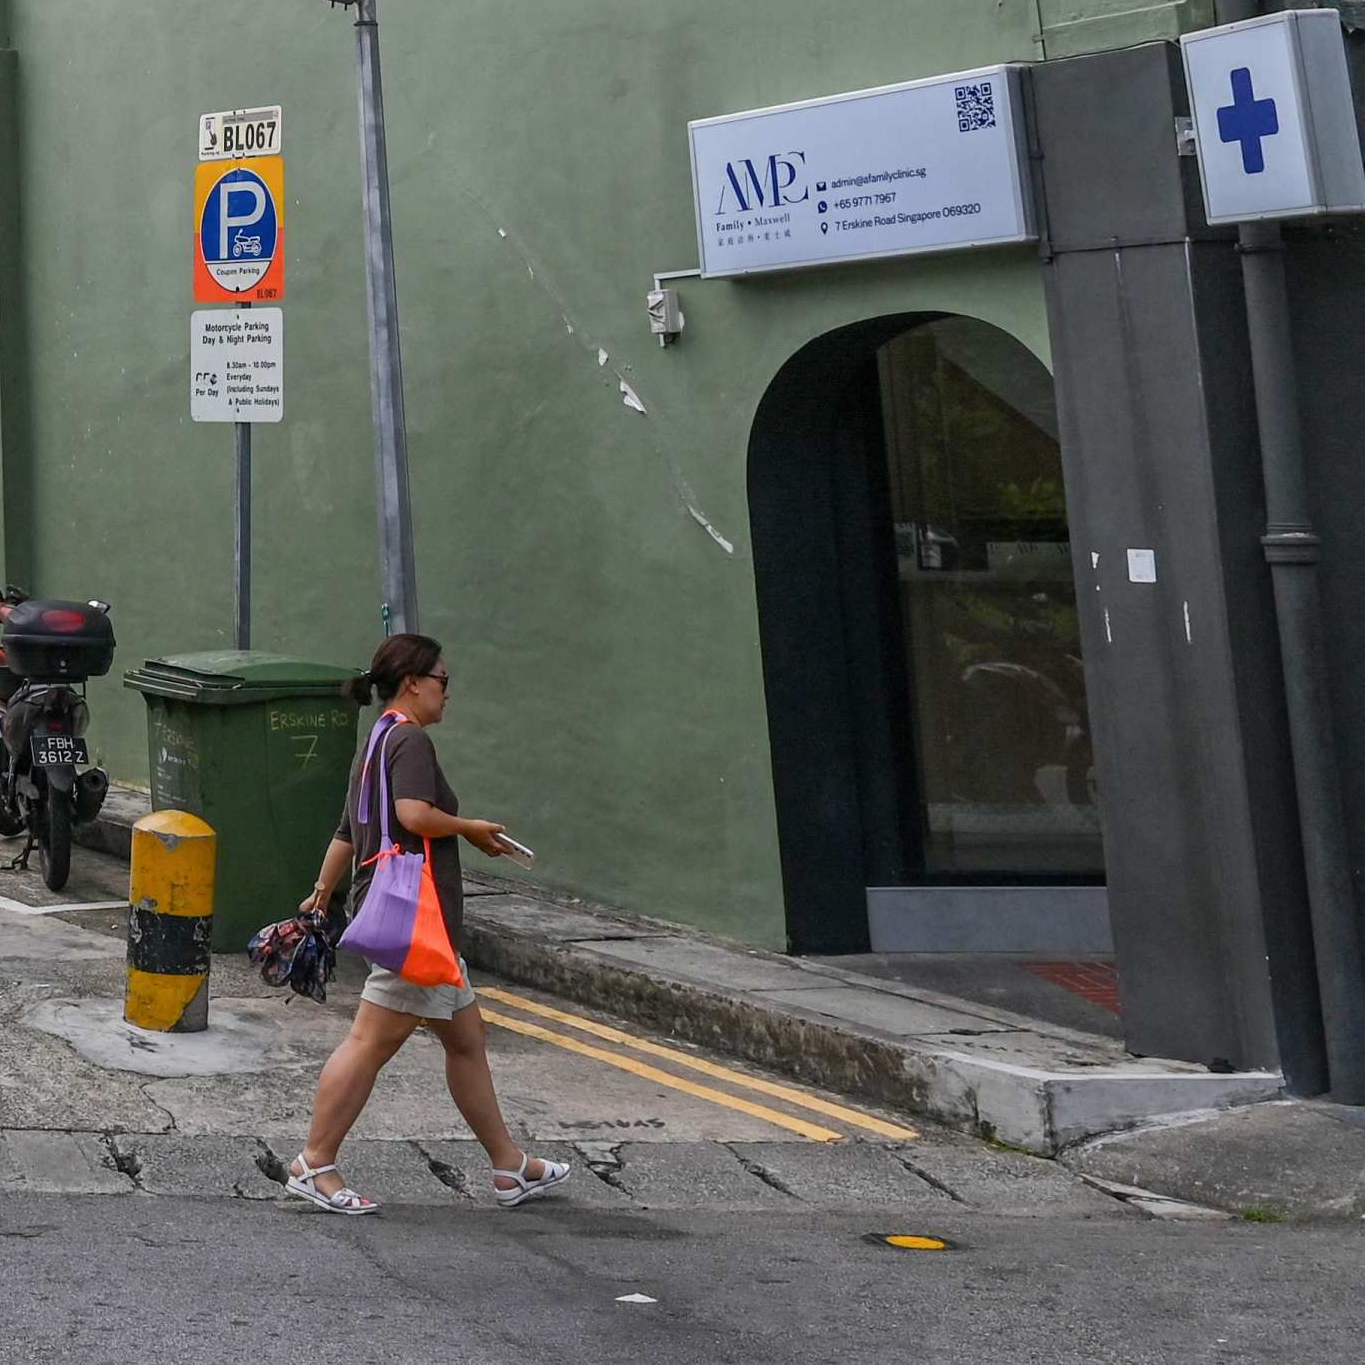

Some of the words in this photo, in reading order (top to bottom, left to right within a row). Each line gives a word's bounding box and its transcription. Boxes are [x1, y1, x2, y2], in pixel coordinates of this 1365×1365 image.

[223, 121, 277, 152] BL067
[831, 167, 927, 189] admin@afamilyclinic.sg
[834, 198, 852, 210] +65
[853, 195, 873, 208] 9771
[219, 181, 267, 259] P
[716, 220, 745, 232] Family
[754, 213, 791, 227] Maxwell
[835, 221, 841, 231] 7
[842, 219, 873, 231] Erskine
[874, 214, 896, 227] Road
[897, 209, 942, 225] Singapore
[942, 202, 982, 218] 069320
[216, 268, 238, 276] Coupon
[239, 267, 260, 276] Parking
[205, 323, 242, 333] Motorcycle
[244, 322, 269, 332] Parking
[202, 335, 216, 346] Day
[218, 335, 224, 344] &
[226, 334, 245, 346] Night
[246, 334, 272, 345] Parking
[226, 373, 252, 382] Everyday
[195, 388, 206, 396] Per
[207, 388, 219, 398] Day
[256, 384, 279, 394] Sundays
[270, 710, 326, 731] ERSKINE
[47, 737, 74, 750] FBH
[290, 734, 319, 770] 7
